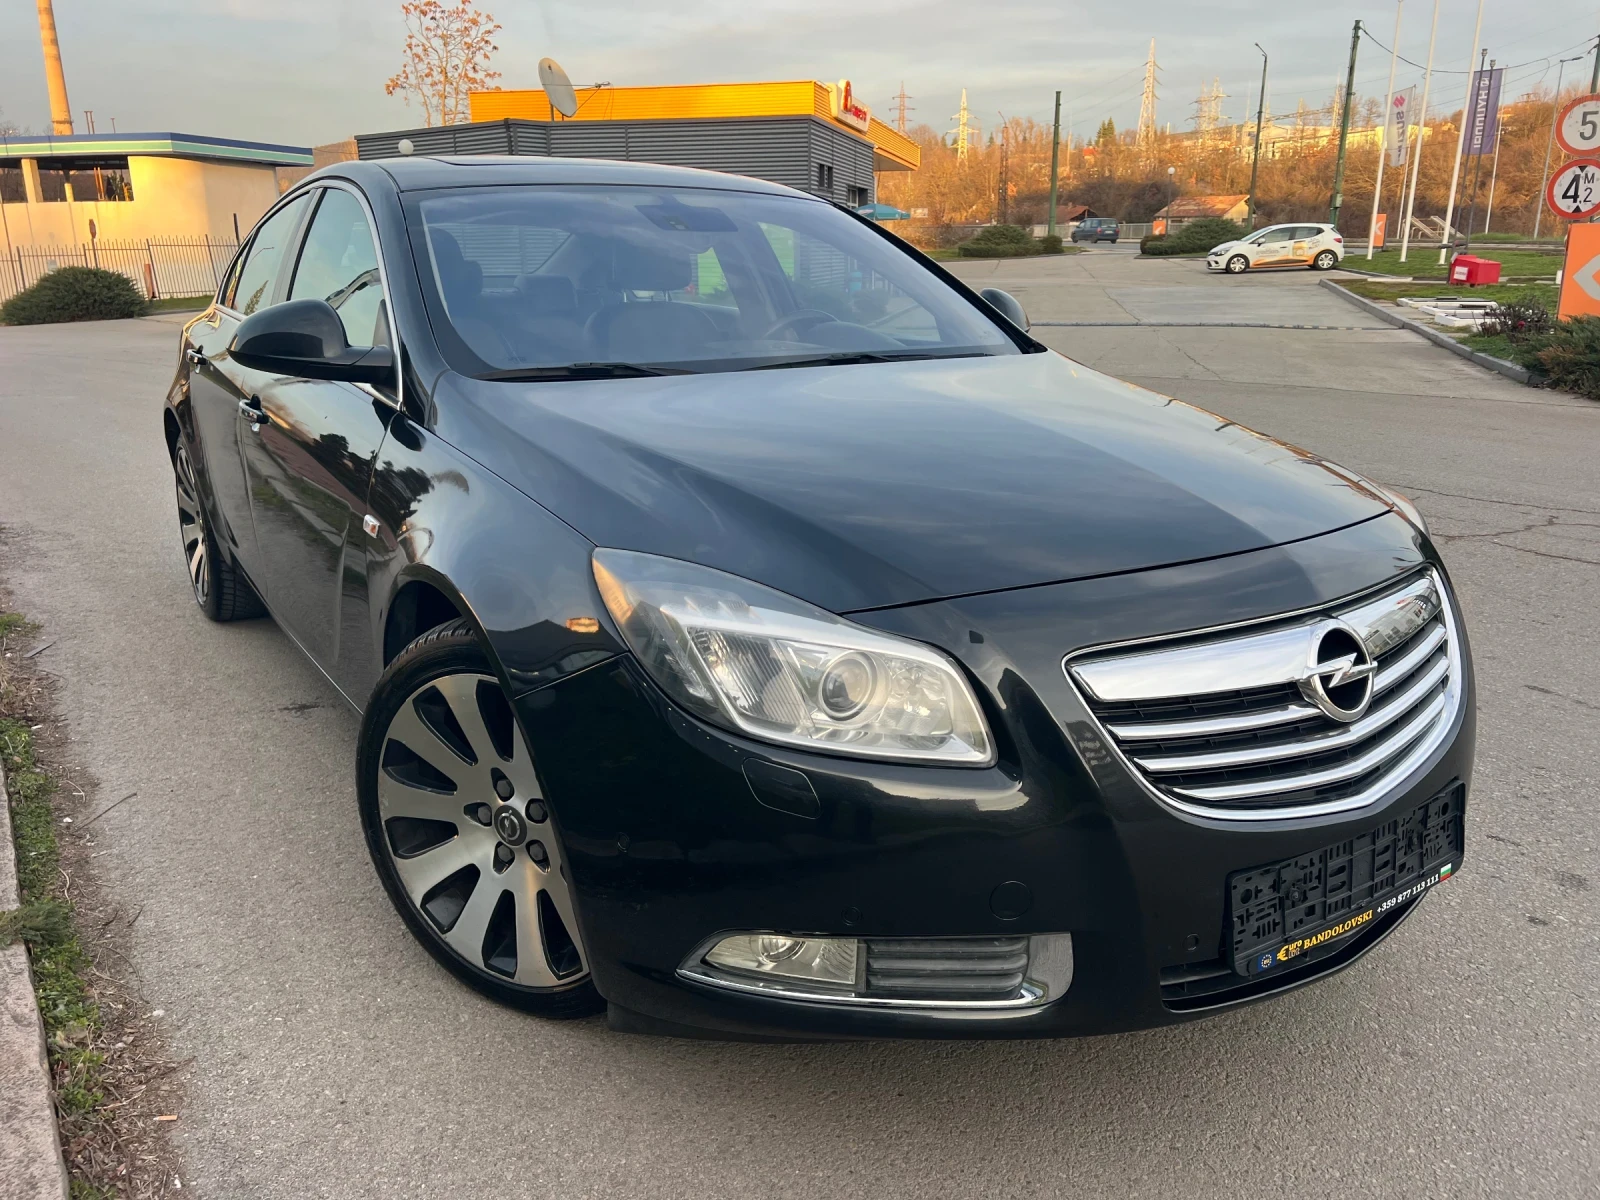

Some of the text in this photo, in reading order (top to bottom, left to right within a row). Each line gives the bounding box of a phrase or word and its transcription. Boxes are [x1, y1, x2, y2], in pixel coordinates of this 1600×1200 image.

[1304, 910, 1373, 949] BANDOLOVSKI
[1377, 898, 1396, 913] +359
[1398, 889, 1411, 903] 877
[1413, 881, 1425, 895] 113
[1426, 873, 1439, 887] 111
